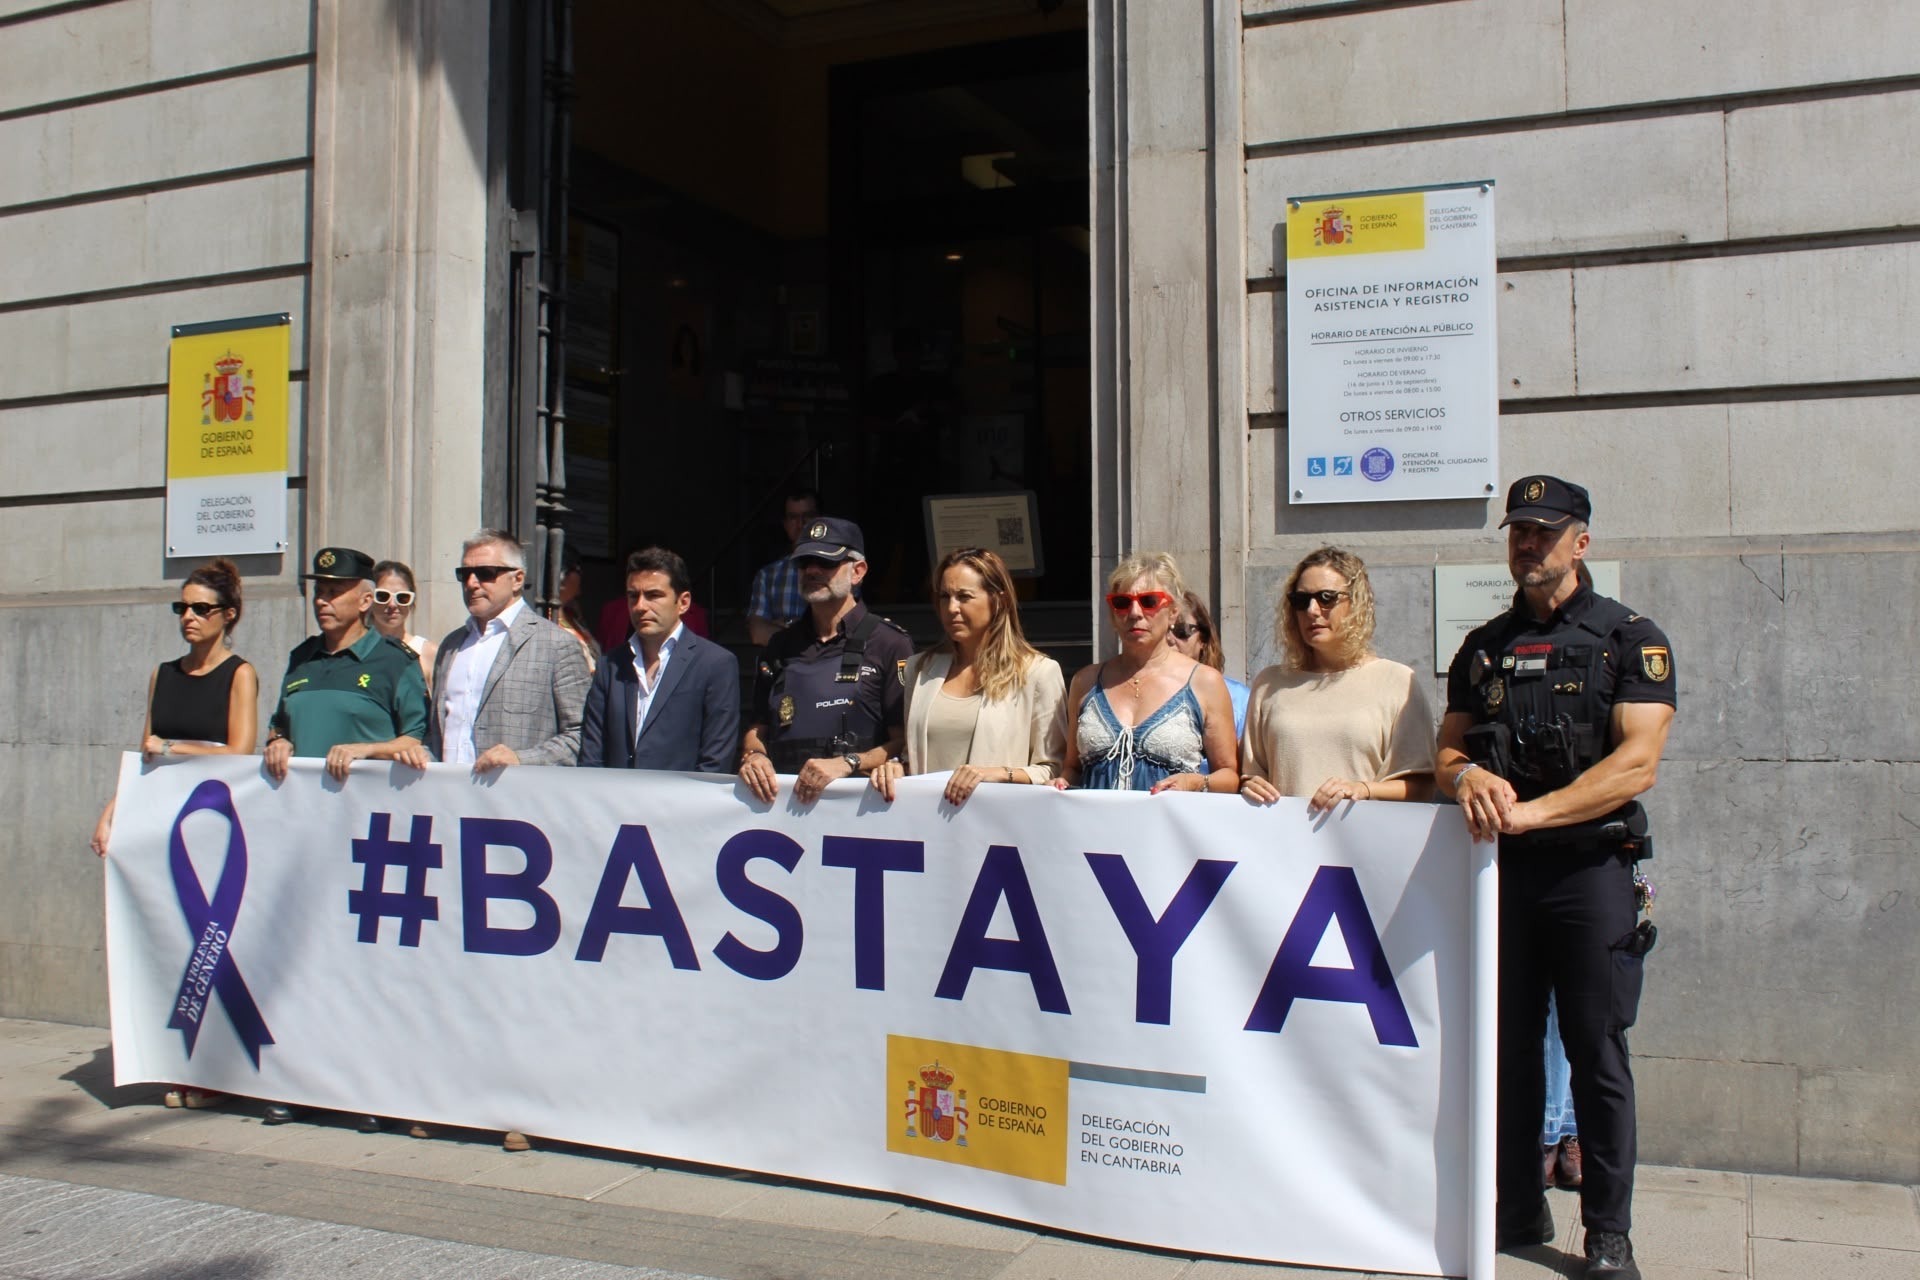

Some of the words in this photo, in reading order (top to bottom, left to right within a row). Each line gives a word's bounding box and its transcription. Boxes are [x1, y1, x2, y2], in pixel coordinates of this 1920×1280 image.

[1360, 213, 1398, 222] GOBIERNO
[1429, 206, 1471, 215] DELEGACIÓN
[1371, 221, 1398, 229] ESPAÑA
[1429, 215, 1440, 223] DEL
[1442, 214, 1478, 222] GOBIERNO
[1430, 223, 1439, 231] EN
[1440, 222, 1477, 230] CANTABRIA
[1305, 286, 1359, 299] OFICINA
[1363, 285, 1379, 296] DE
[1384, 276, 1479, 293] INFORMACIÓN
[1314, 298, 1389, 312] ASISTENCIA
[1393, 298, 1400, 307] Y
[1405, 292, 1470, 306] REGISTRO
[1311, 330, 1353, 340] HORARIO
[1355, 329, 1368, 337] DE
[1369, 325, 1418, 336] ATENCIÓN
[1419, 325, 1432, 333] AL
[1433, 321, 1474, 333] PÚBLICO
[1355, 348, 1385, 356] HORARIO
[1340, 411, 1381, 422] OTROS
[1385, 408, 1445, 420] SERVICIOS
[201, 429, 253, 444] GOBIERNO
[201, 447, 214, 458] DE
[216, 443, 253, 457] ESPAÑA
[200, 496, 251, 507] DELEGACIÓN
[197, 512, 211, 521] DEL
[213, 508, 255, 520] GOBIERNO
[197, 525, 208, 534] EN
[209, 522, 254, 533] CANTABRIA
[816, 698, 849, 708] POLICIA
[348, 812, 1420, 1048] #BASTAYA
[177, 995, 189, 1016] NO
[187, 921, 219, 983] VIOLENCIA
[188, 996, 202, 1023] DE
[195, 930, 227, 996] GENERO
[978, 1096, 1047, 1120] GOBIERNO
[978, 1112, 995, 1127] DE
[998, 1115, 1046, 1137] ESPAÑA
[1081, 1112, 1171, 1137] DELEGACIÓN
[1081, 1131, 1105, 1148] DEL
[1108, 1136, 1184, 1158] GOBIERNO
[1081, 1149, 1098, 1165] EN
[1101, 1153, 1182, 1176] CANTABRIA
